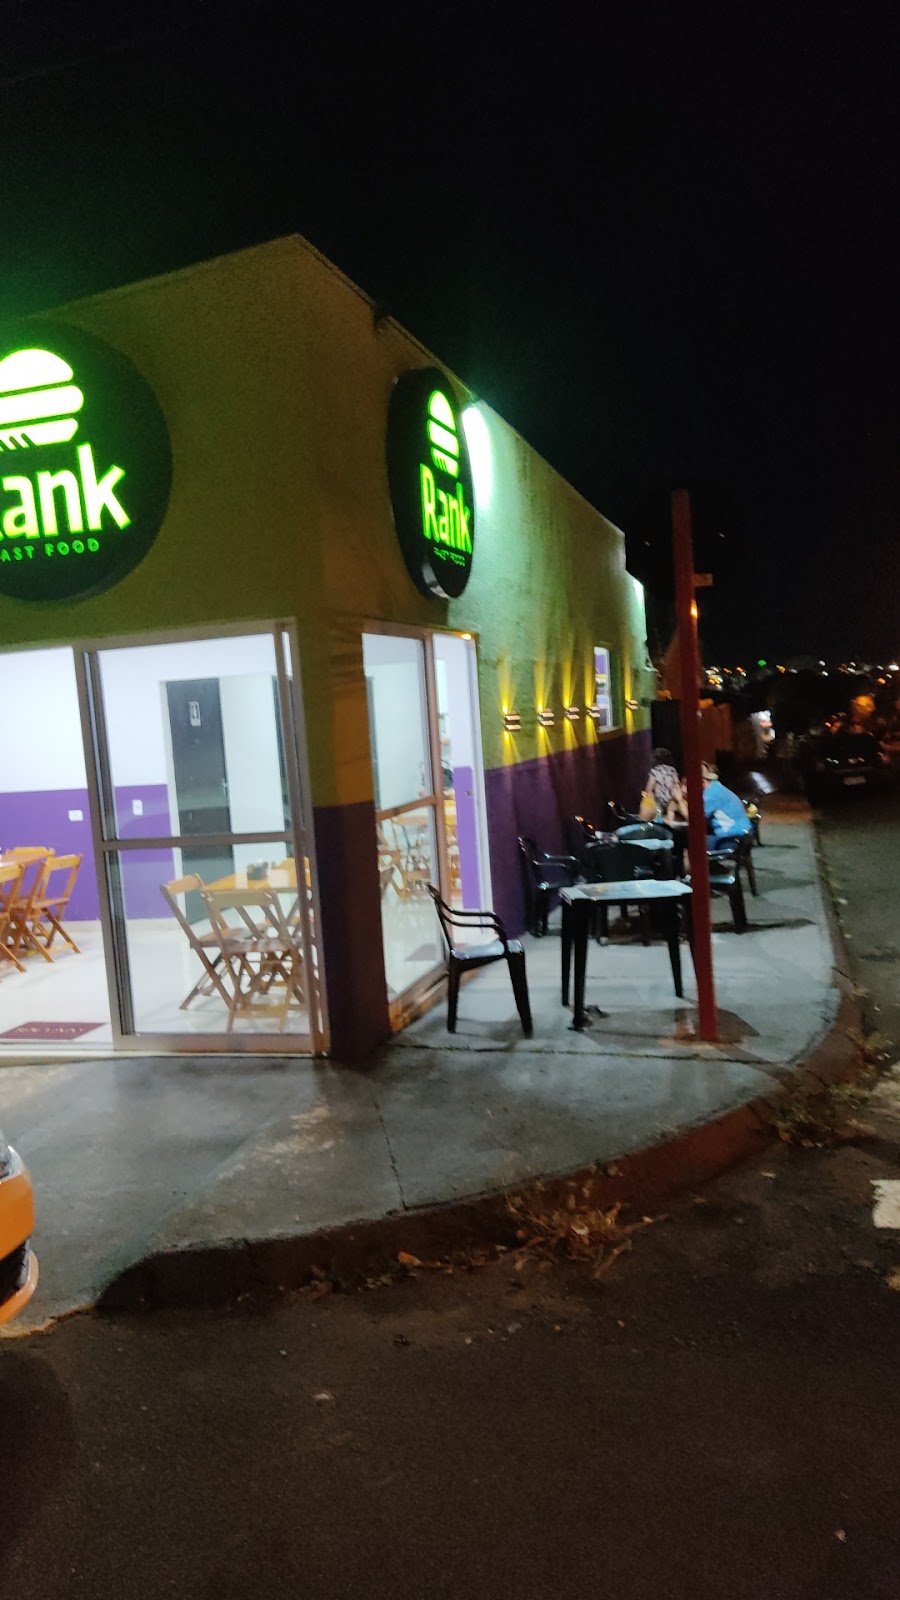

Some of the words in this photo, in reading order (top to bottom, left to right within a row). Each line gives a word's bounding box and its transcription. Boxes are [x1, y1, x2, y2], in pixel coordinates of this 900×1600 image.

[0, 442, 132, 539] ank
[420, 463, 473, 554] Rank
[0, 545, 35, 562] AST
[44, 538, 100, 557] FOOD
